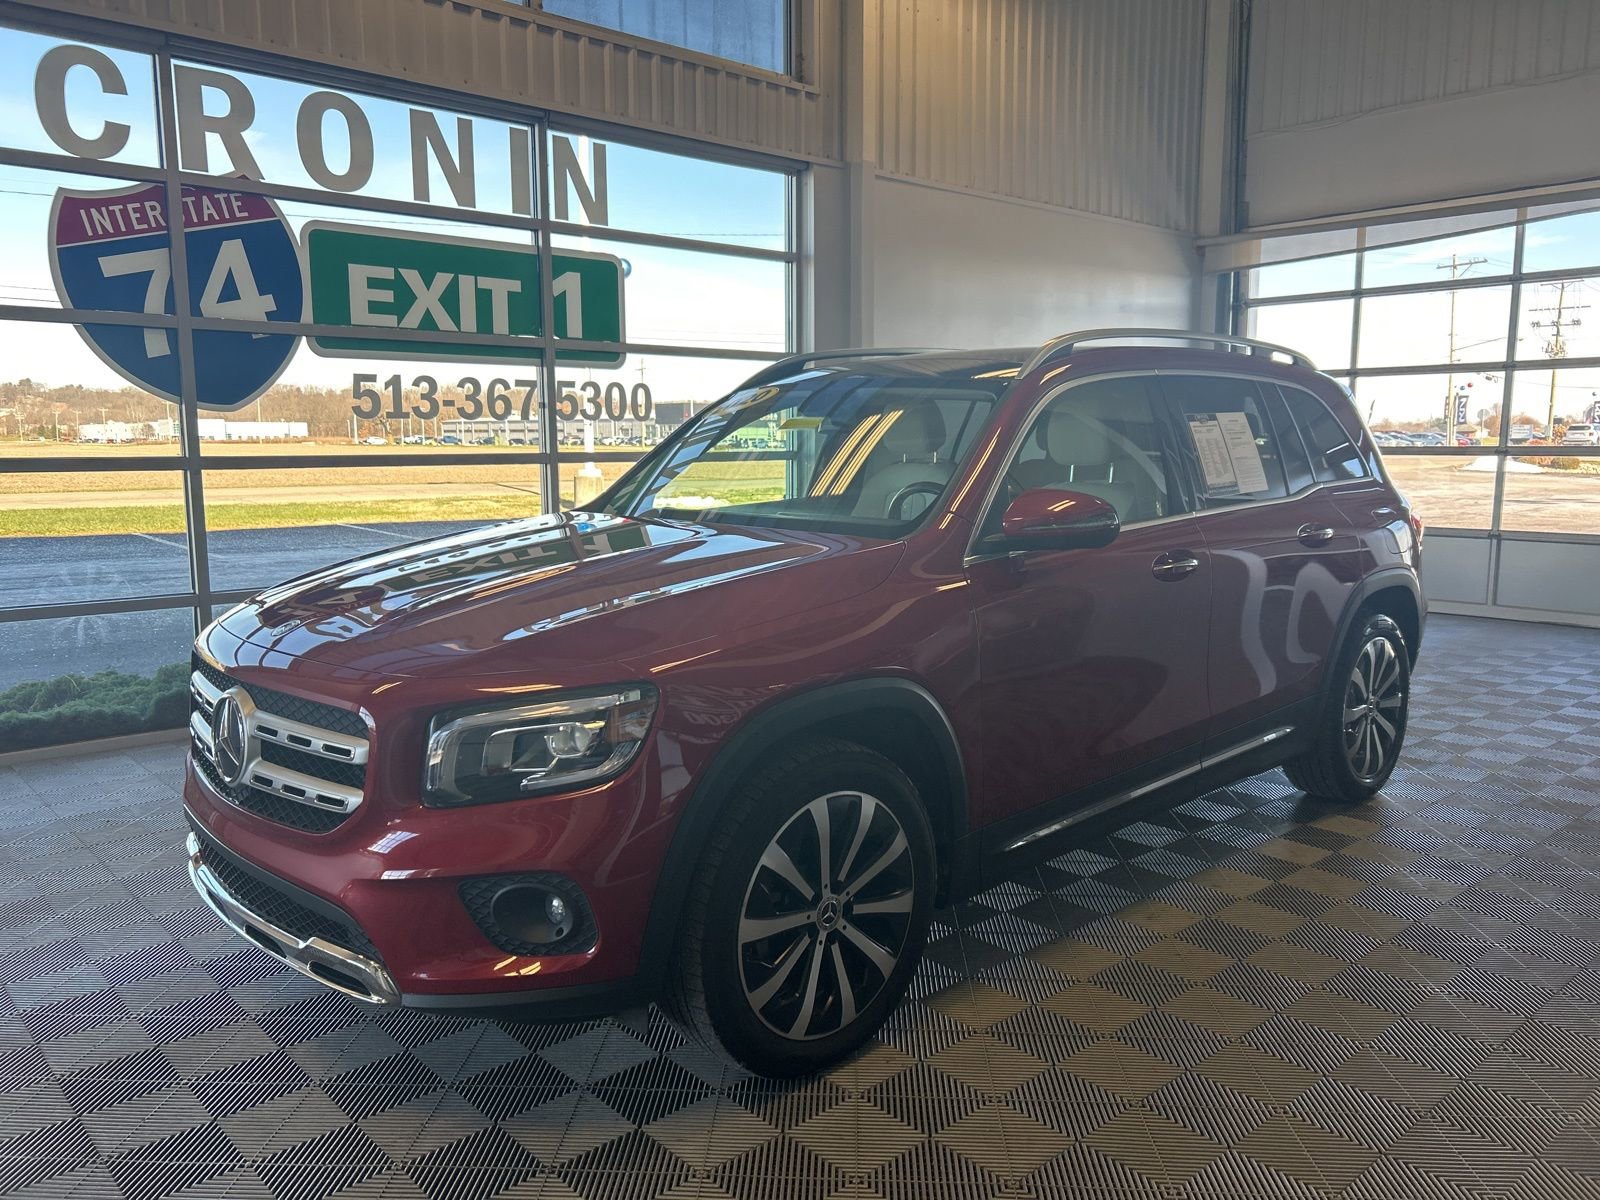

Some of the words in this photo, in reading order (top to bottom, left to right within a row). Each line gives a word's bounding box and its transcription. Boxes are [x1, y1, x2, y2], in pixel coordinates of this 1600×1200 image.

[34, 45, 609, 226] CRONIN
[79, 192, 249, 237] INTERTATE
[97, 239, 278, 358] 74
[347, 263, 522, 335] EXIT
[552, 271, 583, 339] 1
